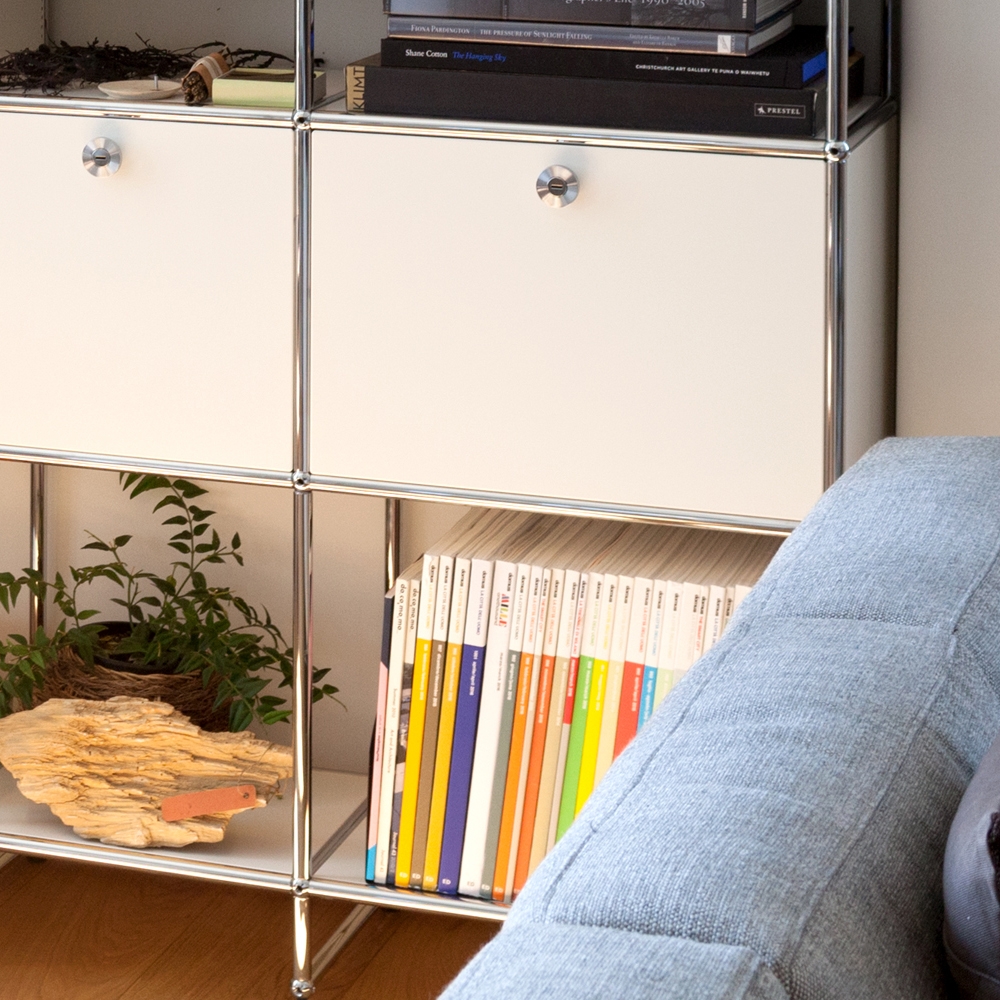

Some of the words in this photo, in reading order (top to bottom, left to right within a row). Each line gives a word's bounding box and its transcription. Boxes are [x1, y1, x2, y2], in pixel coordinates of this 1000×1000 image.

[405, 49, 425, 57] Shane
[426, 49, 448, 58] Cotton
[465, 51, 493, 62] Hanging
[635, 64, 675, 72] CHRISTCHURCH
[353, 67, 365, 111] KLIMT
[767, 106, 801, 115] PRESTEL
